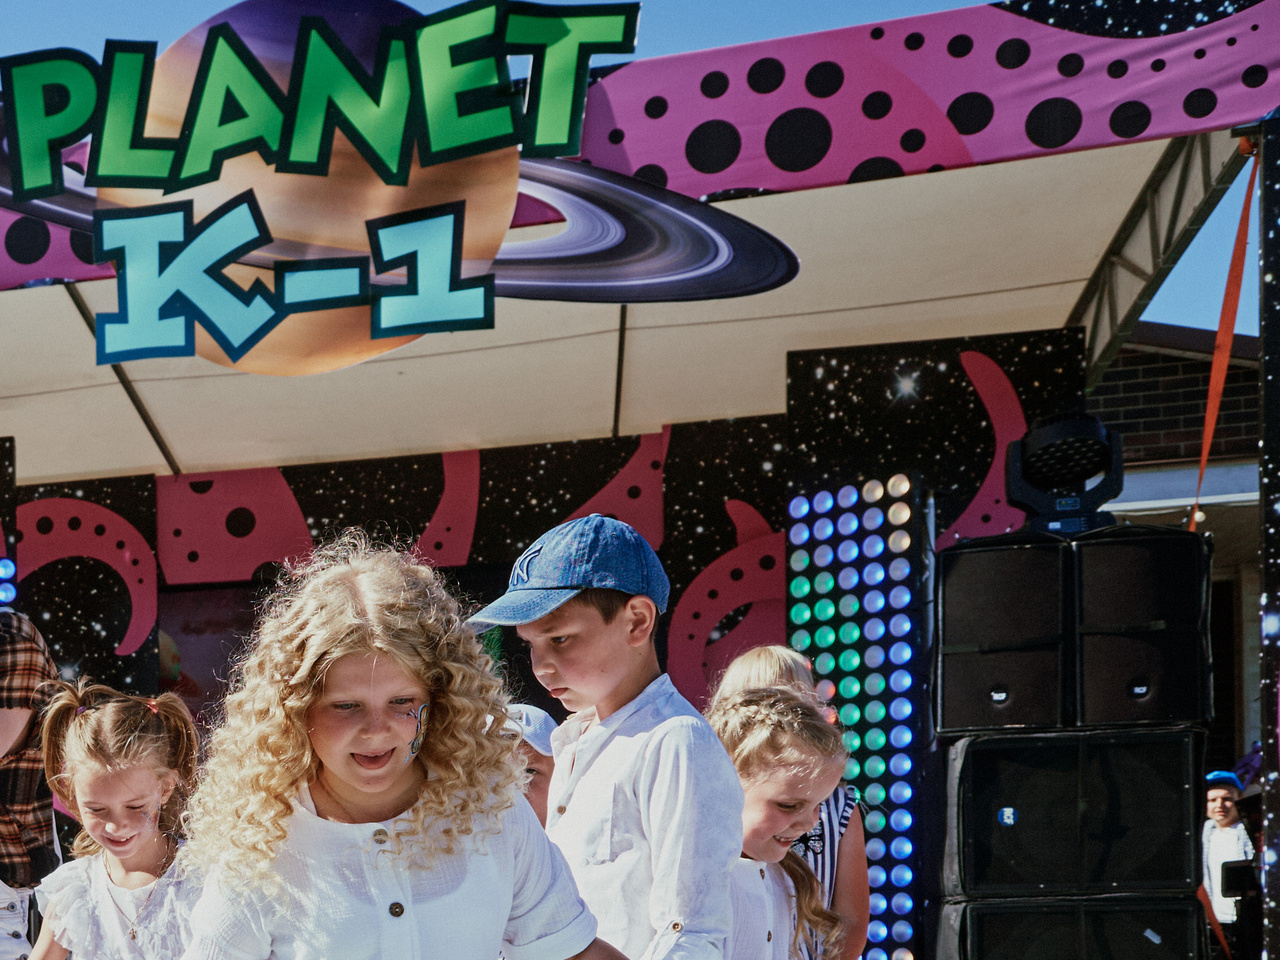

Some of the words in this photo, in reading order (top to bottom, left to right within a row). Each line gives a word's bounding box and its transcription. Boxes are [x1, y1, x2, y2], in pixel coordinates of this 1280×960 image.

[0, 2, 640, 198] PLANET
[94, 189, 494, 364] K-1
[1003, 807, 1015, 826] RCF
